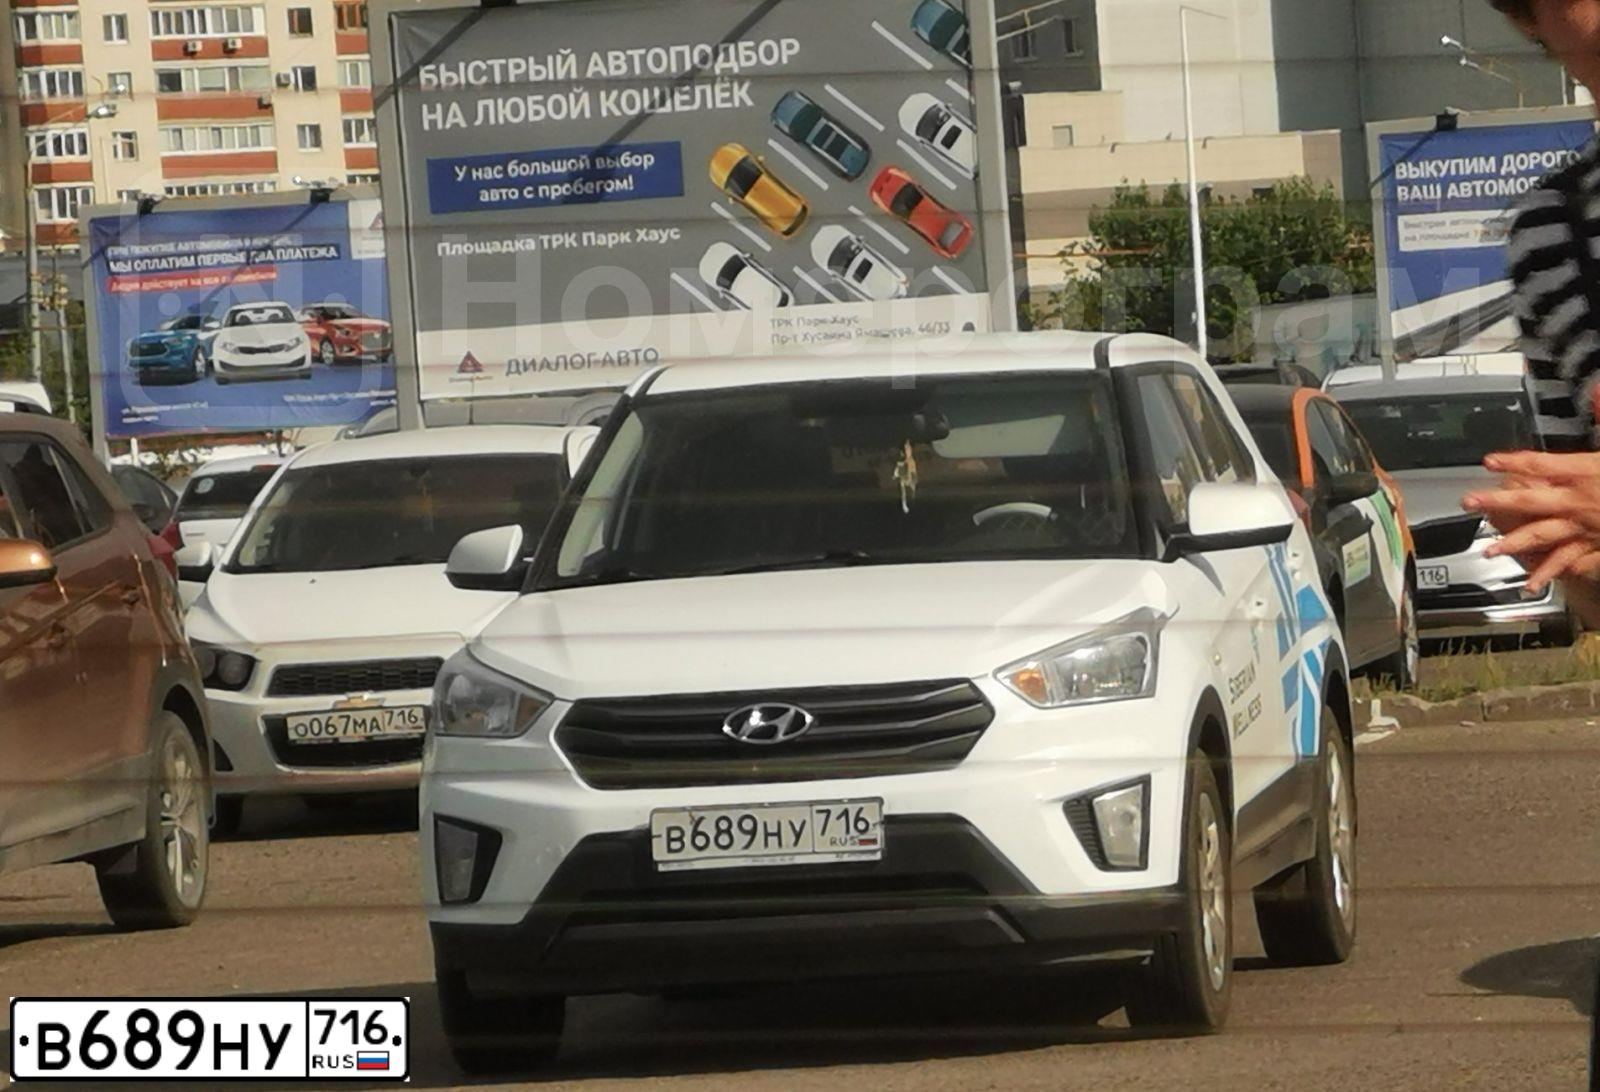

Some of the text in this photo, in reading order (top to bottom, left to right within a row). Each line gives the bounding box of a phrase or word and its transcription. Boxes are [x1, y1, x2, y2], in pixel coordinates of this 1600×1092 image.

[419, 38, 801, 90] БЫСТРЫЙ АВТОПОДБОР
[422, 76, 755, 131] НА ЛЮБОЙ КОШЕЛЁК
[454, 151, 655, 182] У нас большой выбор
[1395, 156, 1497, 180] ВЫКУПИМ
[479, 174, 635, 203] авто с пробегом!
[1396, 184, 1443, 202] ВАШ
[275, 246, 339, 262] ПЛАТЕЖА
[437, 227, 682, 257] Площадка ТРК Парк Хаус
[1419, 569, 1445, 582] 116
[384, 708, 419, 726] 716
[665, 806, 870, 854] В689НУ 716
[830, 836, 857, 847] RUS
